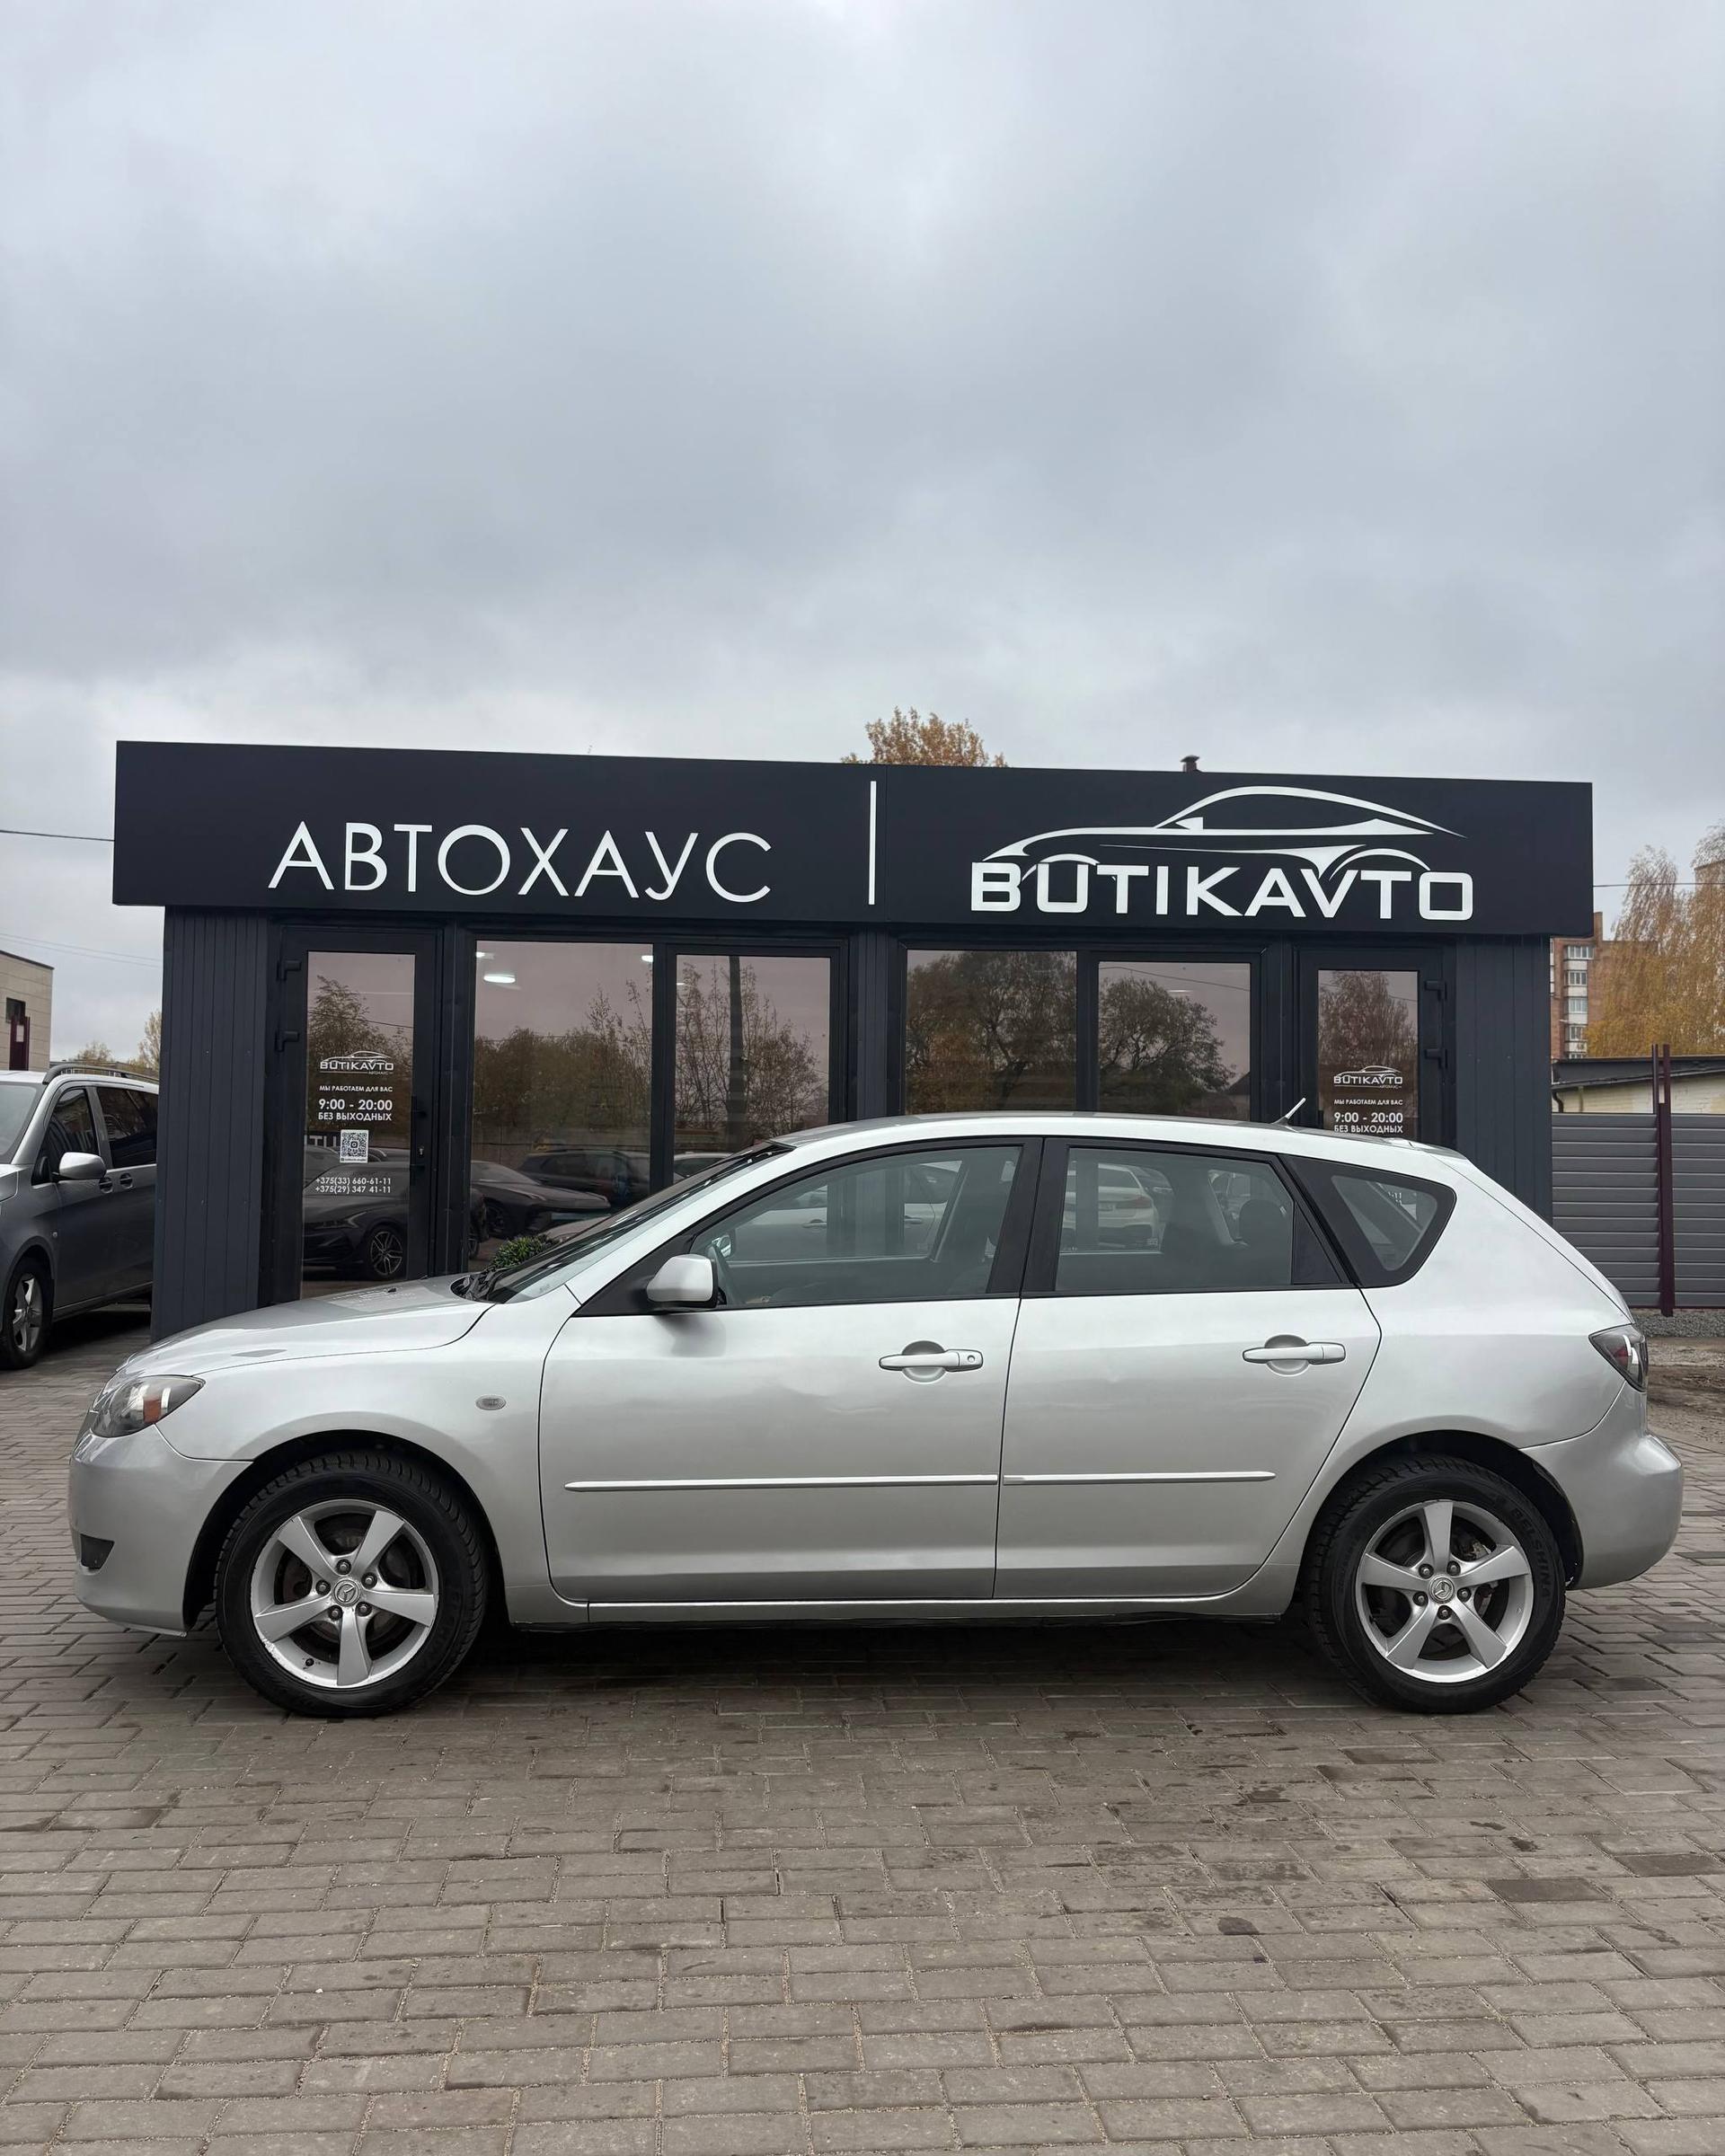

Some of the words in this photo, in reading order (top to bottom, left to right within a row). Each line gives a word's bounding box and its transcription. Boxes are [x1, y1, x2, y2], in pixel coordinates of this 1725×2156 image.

[268, 820, 772, 904] АВТОХАУС
[971, 861, 1473, 921] BUTIKAVTO
[320, 1061, 394, 1070] BUTIKAVTO
[1334, 1075, 1402, 1084] BUTIKAVTO
[319, 1099, 345, 1110] 9:00
[358, 1100, 393, 1111] 20:00
[318, 1112, 333, 1120] БЕЗ
[336, 1112, 392, 1121] ВЫХОДНЫХ
[1334, 1112, 1358, 1123] 9:00
[1371, 1112, 1403, 1123] 20:00
[1334, 1125, 1349, 1133] БЕЗ
[1351, 1125, 1403, 1134] ВЫХОДНЫХ
[315, 1177, 350, 1186] +375(33)
[352, 1177, 391, 1185] 660-61-11
[315, 1186, 350, 1194] +375(29)
[1509, 1507, 1552, 1598] BELSHINA
